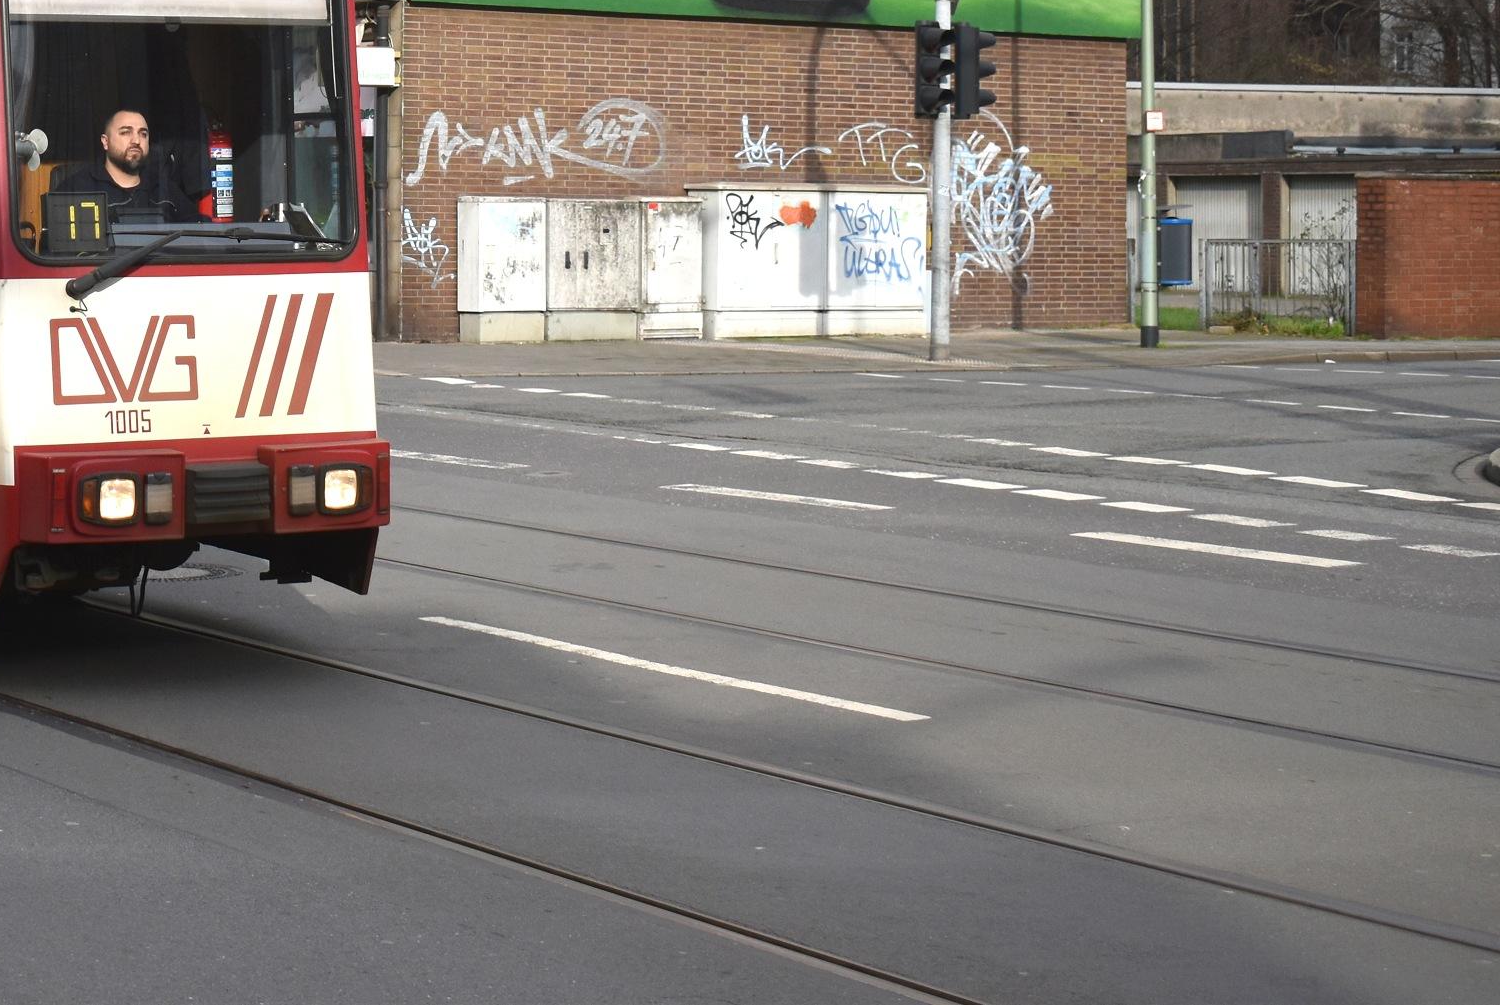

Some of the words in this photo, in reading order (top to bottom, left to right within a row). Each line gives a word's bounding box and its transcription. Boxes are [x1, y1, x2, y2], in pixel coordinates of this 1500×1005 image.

[68, 202, 100, 241] 17
[50, 315, 199, 406] DVG
[105, 408, 151, 434] 1005
